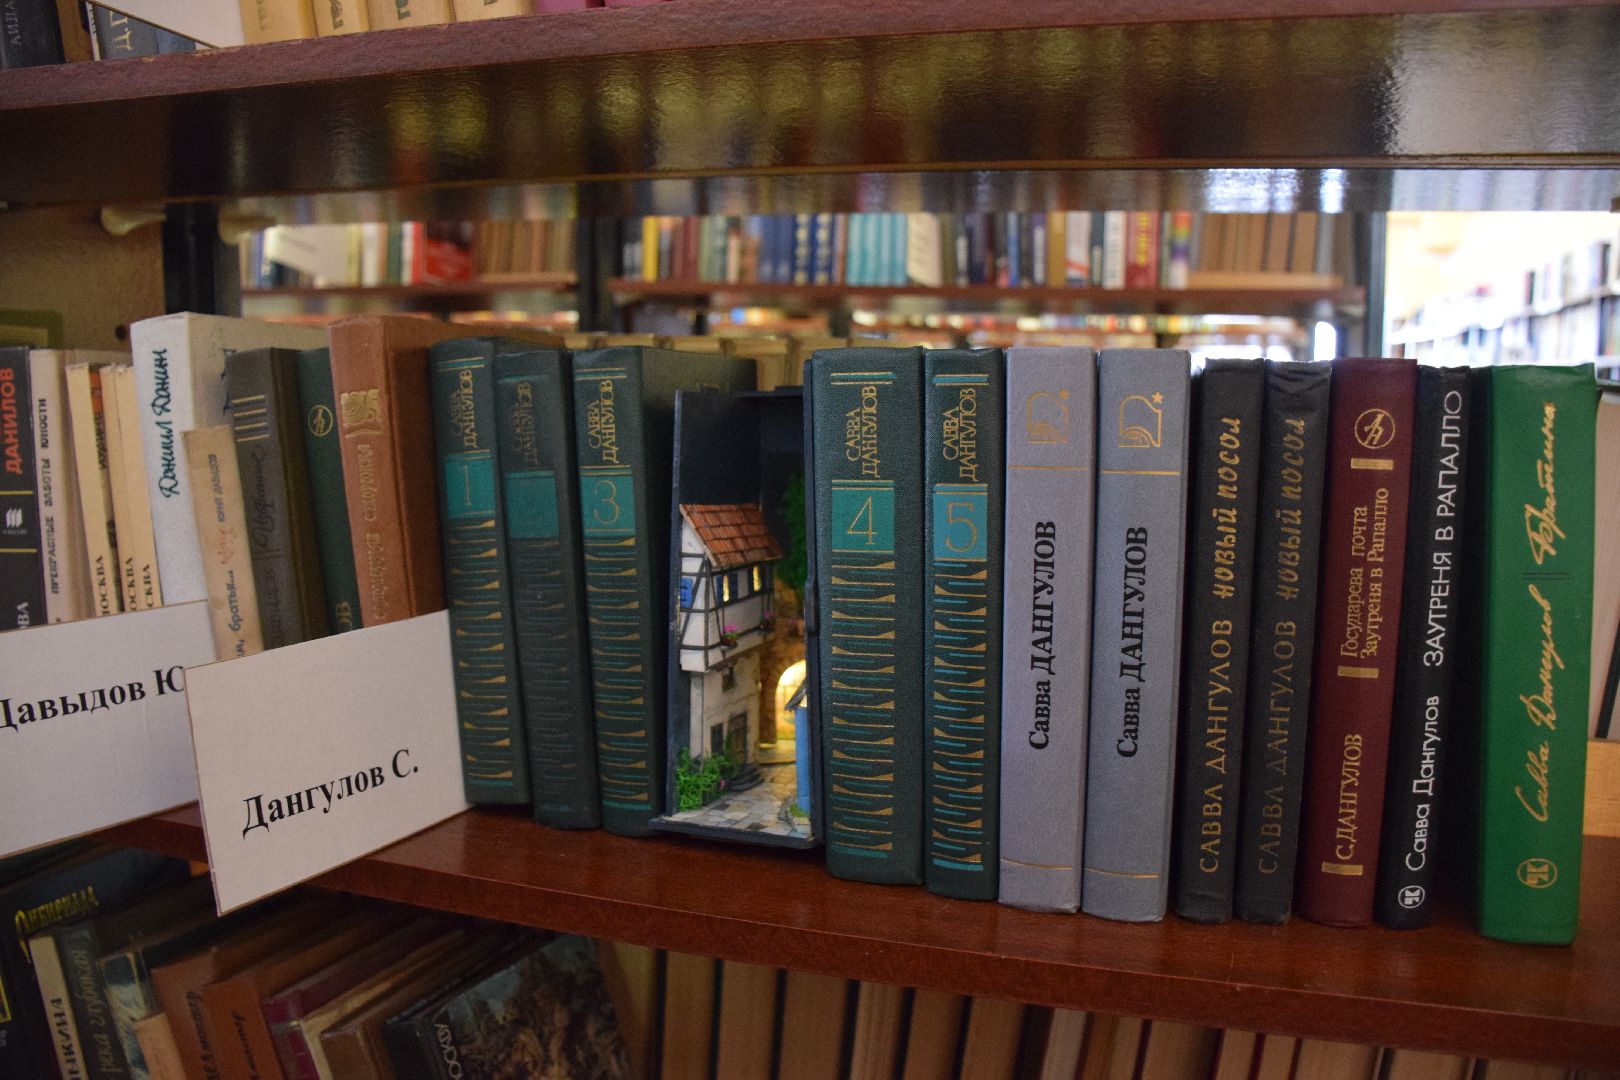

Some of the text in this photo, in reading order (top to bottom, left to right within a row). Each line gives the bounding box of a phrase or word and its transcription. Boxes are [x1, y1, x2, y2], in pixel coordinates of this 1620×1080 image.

[0, 368, 23, 477] ДАНИЛОВ
[38, 398, 48, 448] ЮНОСТИ
[151, 348, 179, 498] Даниил Данин
[588, 400, 601, 449] САВВА
[600, 379, 621, 464] ДАНГУЛОВ
[846, 407, 862, 462] САВВА
[861, 385, 881, 478] ДАНГУЛОВ
[943, 405, 960, 461] САВВА
[959, 387, 979, 482] ДАНГУЛОВ
[1436, 390, 1463, 517] РАПАЛЛО
[593, 479, 621, 525] 3
[847, 496, 879, 545] 4
[944, 501, 977, 553] 5
[1524, 401, 1567, 565] Братина
[1360, 487, 1389, 660] Заутреня в Рапалло
[1435, 526, 1454, 541] В
[17, 602, 29, 628] ВА
[1340, 506, 1368, 659] Государева почта
[1423, 552, 1453, 667] ЗАУТРЕНЯ
[1028, 520, 1056, 750] Савва ДАНГУЛОВ
[1116, 526, 1148, 758] Савва ДАНГУЛОВ
[1519, 584, 1565, 730] Дангулов
[0, 681, 146, 733] Давыдов
[1205, 619, 1233, 774] ДАНГУЛОВ
[1267, 620, 1297, 776] ДАНГУЛОВ
[1412, 695, 1442, 796] Дангулов
[1514, 740, 1551, 822] Савва
[242, 748, 419, 840] Дангулов С.
[1199, 783, 1225, 874] САВВА
[1258, 784, 1285, 875] САВВА
[1405, 804, 1431, 871] Савва
